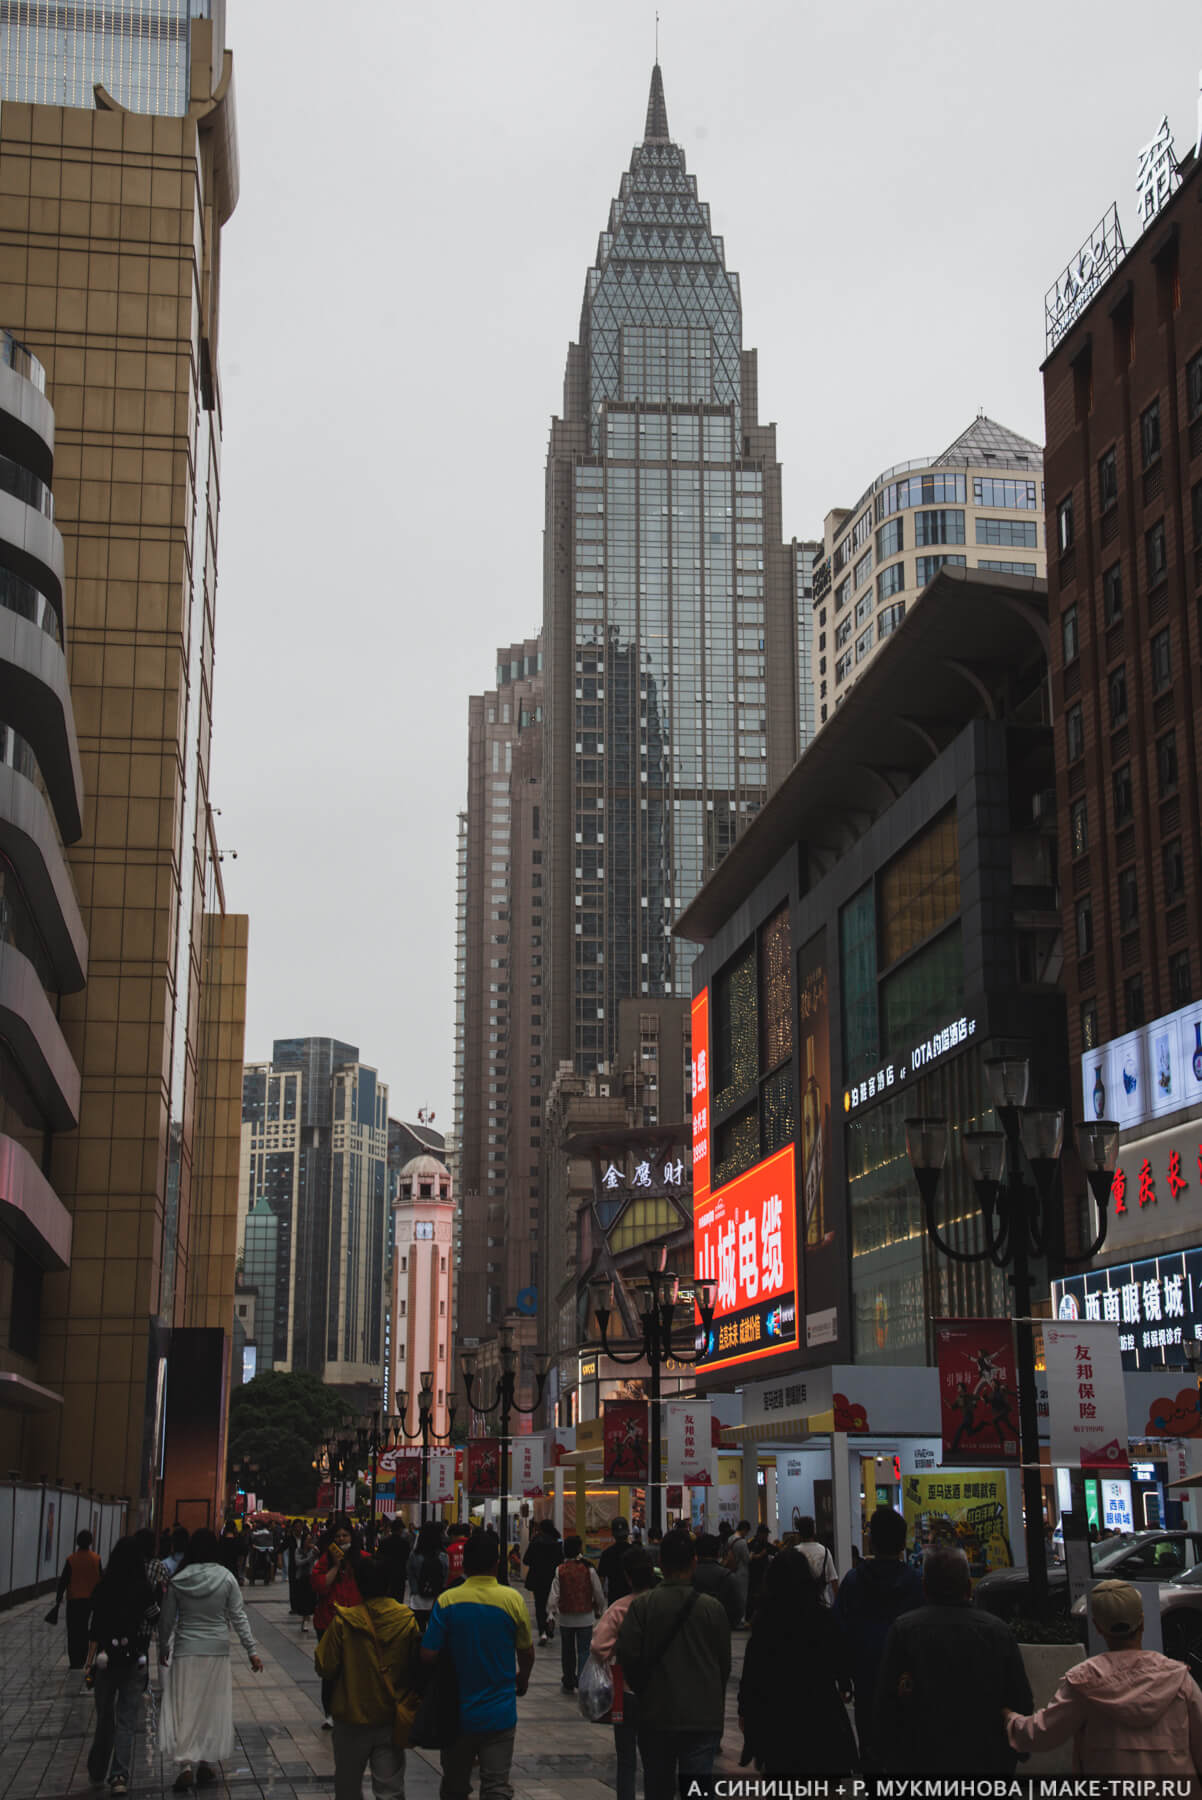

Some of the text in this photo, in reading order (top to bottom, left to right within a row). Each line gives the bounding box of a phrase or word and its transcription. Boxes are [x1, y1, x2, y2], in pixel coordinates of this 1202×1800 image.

[601, 1158, 684, 1189] 金鹰财
[699, 1194, 784, 1310] 山城电缆
[1084, 1274, 1184, 1324] 西南眼镜城
[1142, 1327, 1183, 1349] 斜弱视诊疗
[1073, 1344, 1097, 1419] 友邦保险
